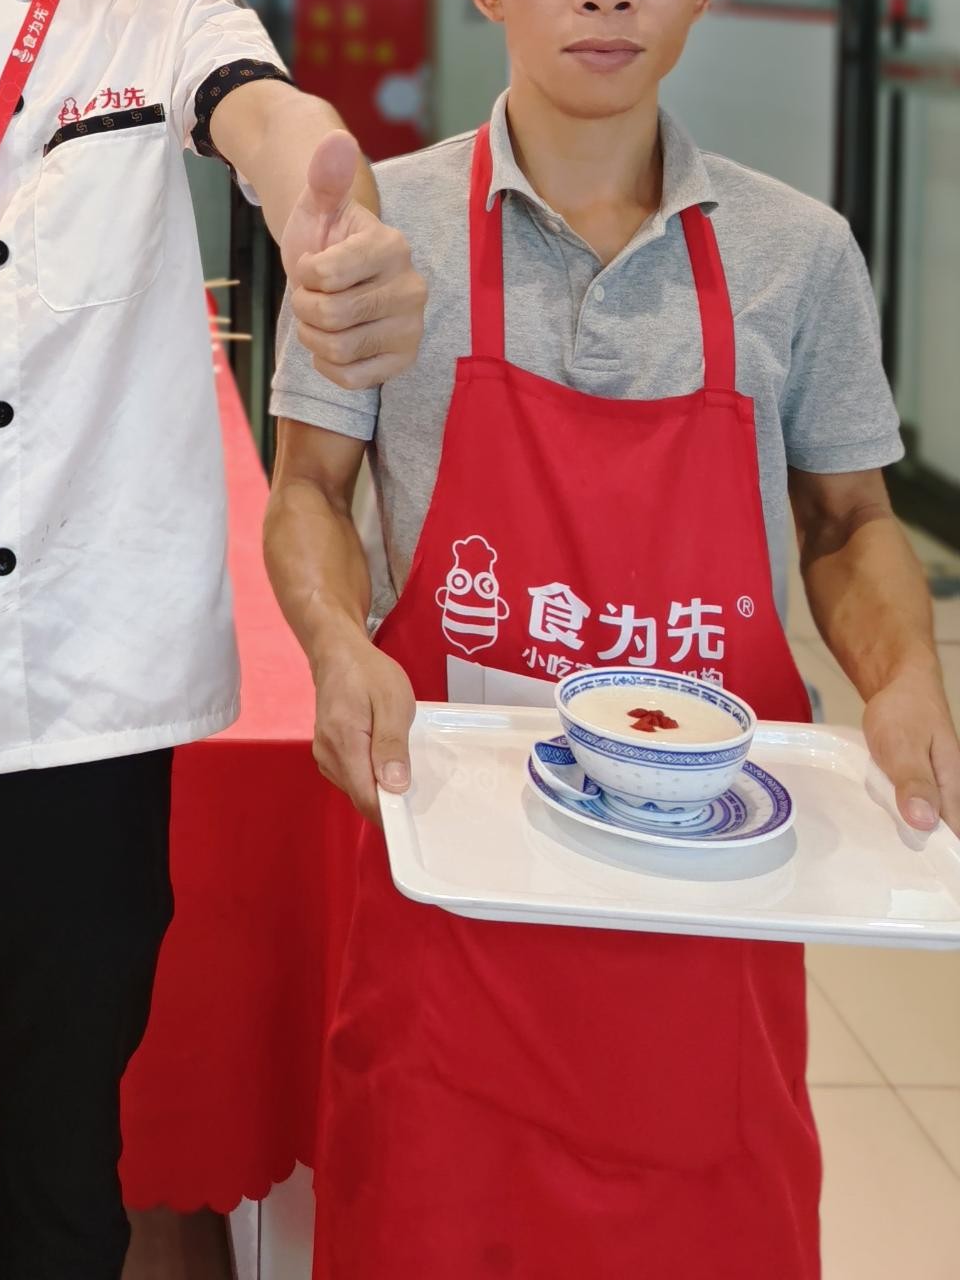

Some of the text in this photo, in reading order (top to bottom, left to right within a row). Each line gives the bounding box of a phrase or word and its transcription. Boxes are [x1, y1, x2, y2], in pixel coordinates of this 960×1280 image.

[83, 87, 146, 116] 为先
[528, 582, 726, 666] 食为先
